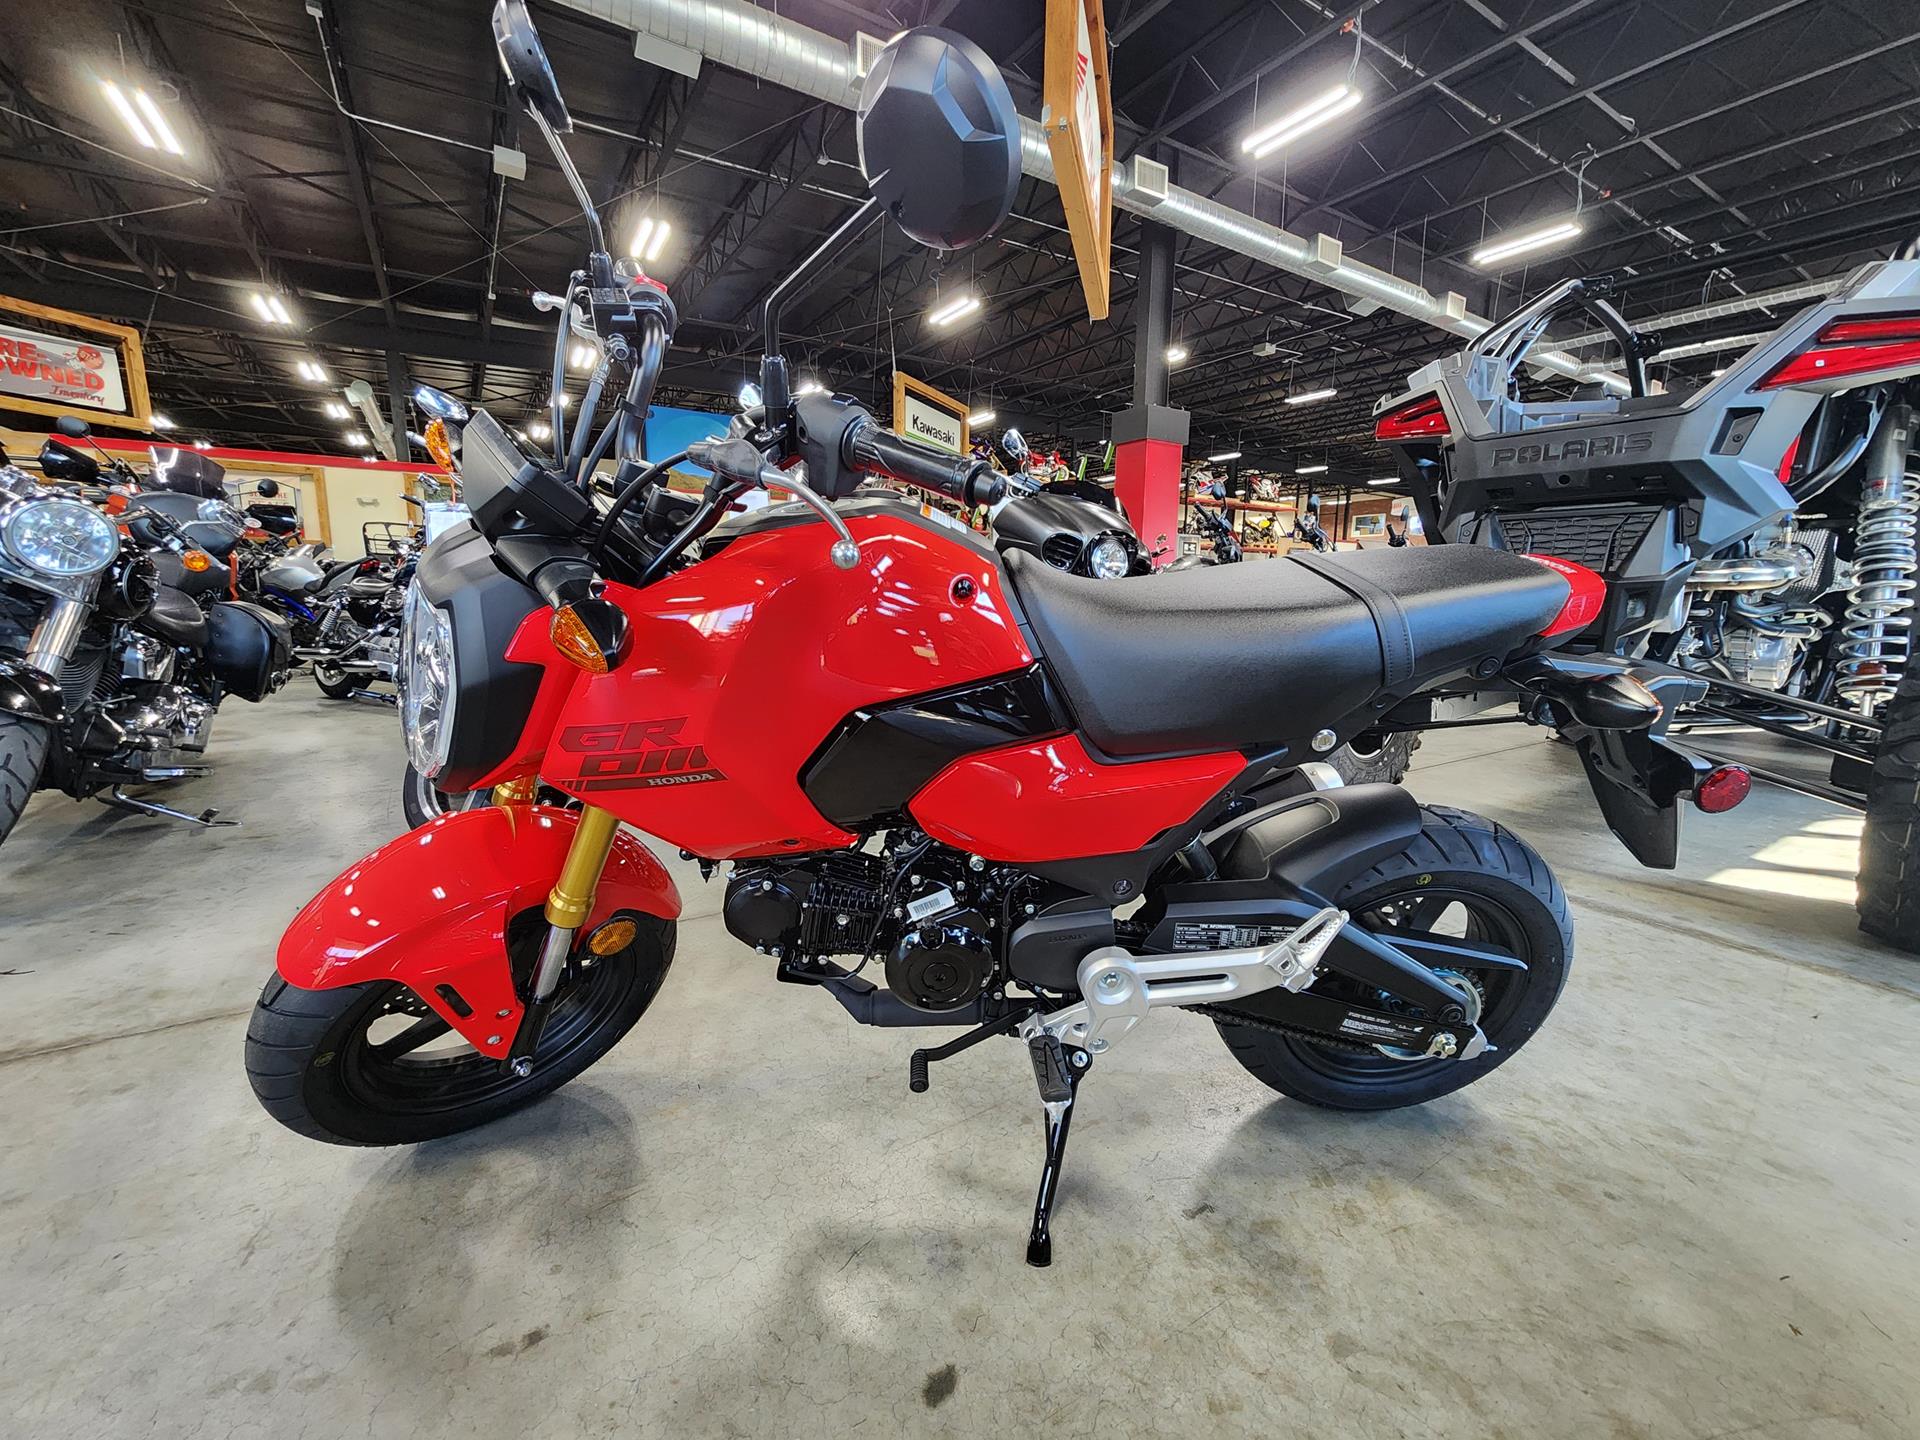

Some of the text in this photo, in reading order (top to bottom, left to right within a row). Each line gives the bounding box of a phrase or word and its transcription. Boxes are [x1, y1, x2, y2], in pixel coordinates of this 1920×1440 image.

[0, 357, 105, 391] WNED
[912, 414, 955, 446] Kawasaki
[1491, 432, 1654, 467] POLARIS
[648, 772, 715, 786] HONDA
